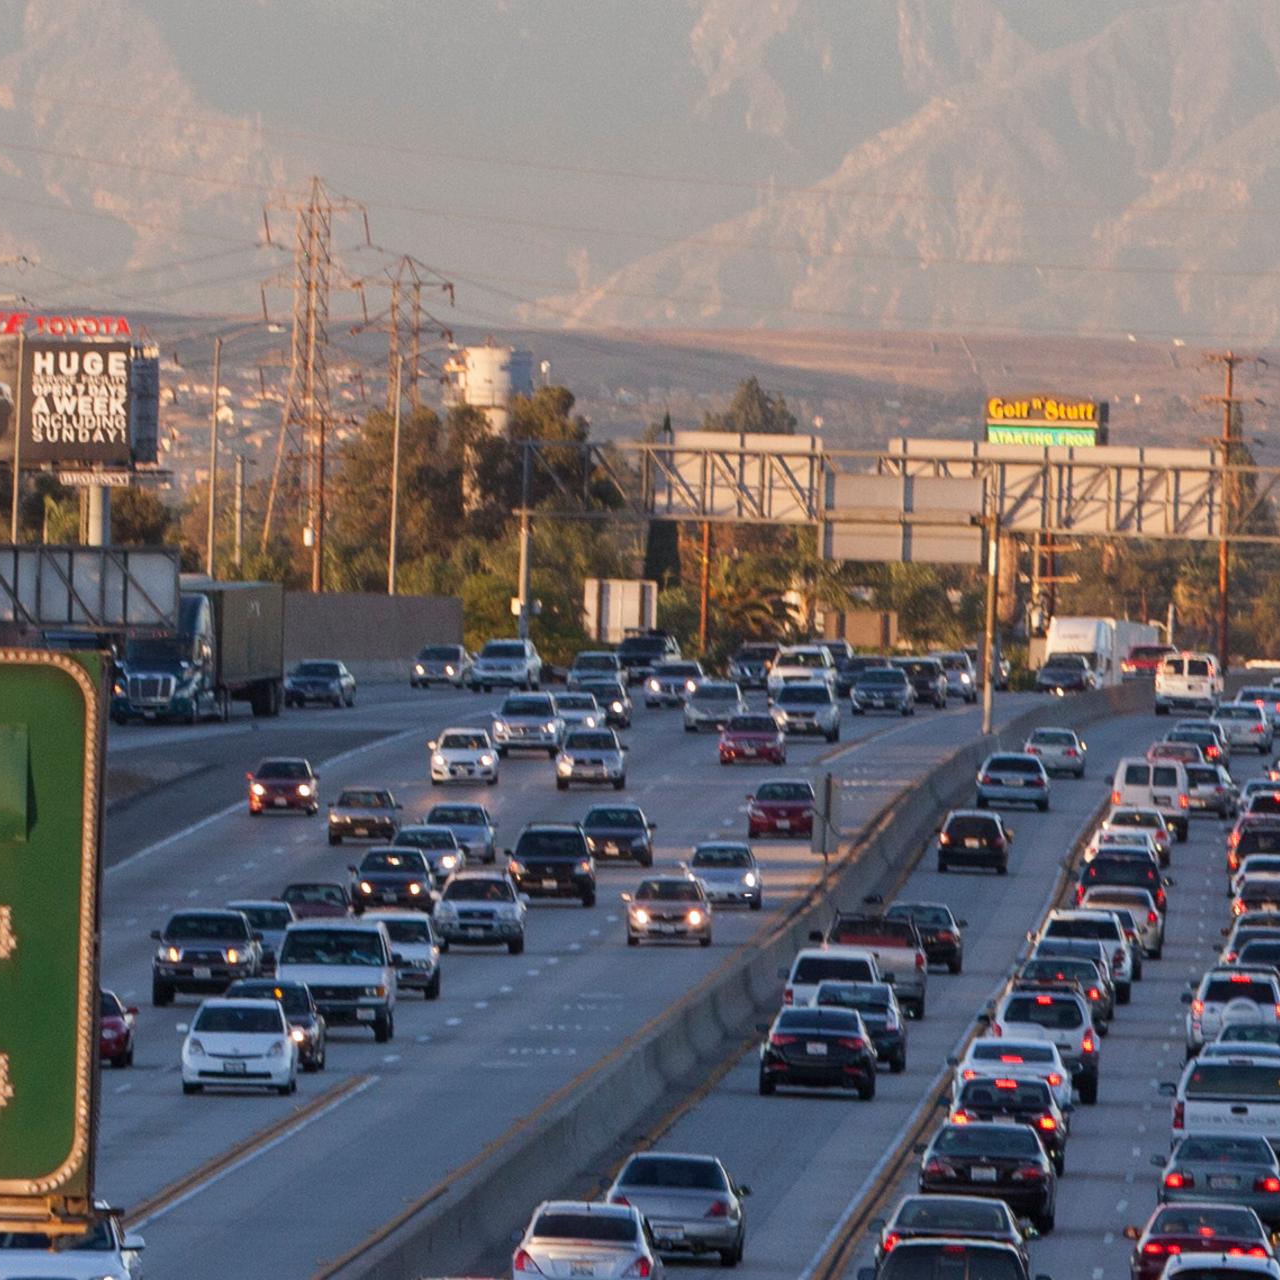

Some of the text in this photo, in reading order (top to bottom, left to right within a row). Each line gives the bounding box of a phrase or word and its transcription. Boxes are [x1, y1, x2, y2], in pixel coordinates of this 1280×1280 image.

[35, 316, 132, 336] TOYOTA
[33, 351, 127, 376] HUGE
[32, 384, 73, 397] OPEN
[88, 384, 127, 398] DAYS
[32, 396, 127, 417] A WEEK
[988, 397, 1029, 419] Golf
[1045, 399, 1095, 421] Stuff
[32, 414, 127, 430] INCLUDING
[32, 427, 126, 444] SUNDAY!
